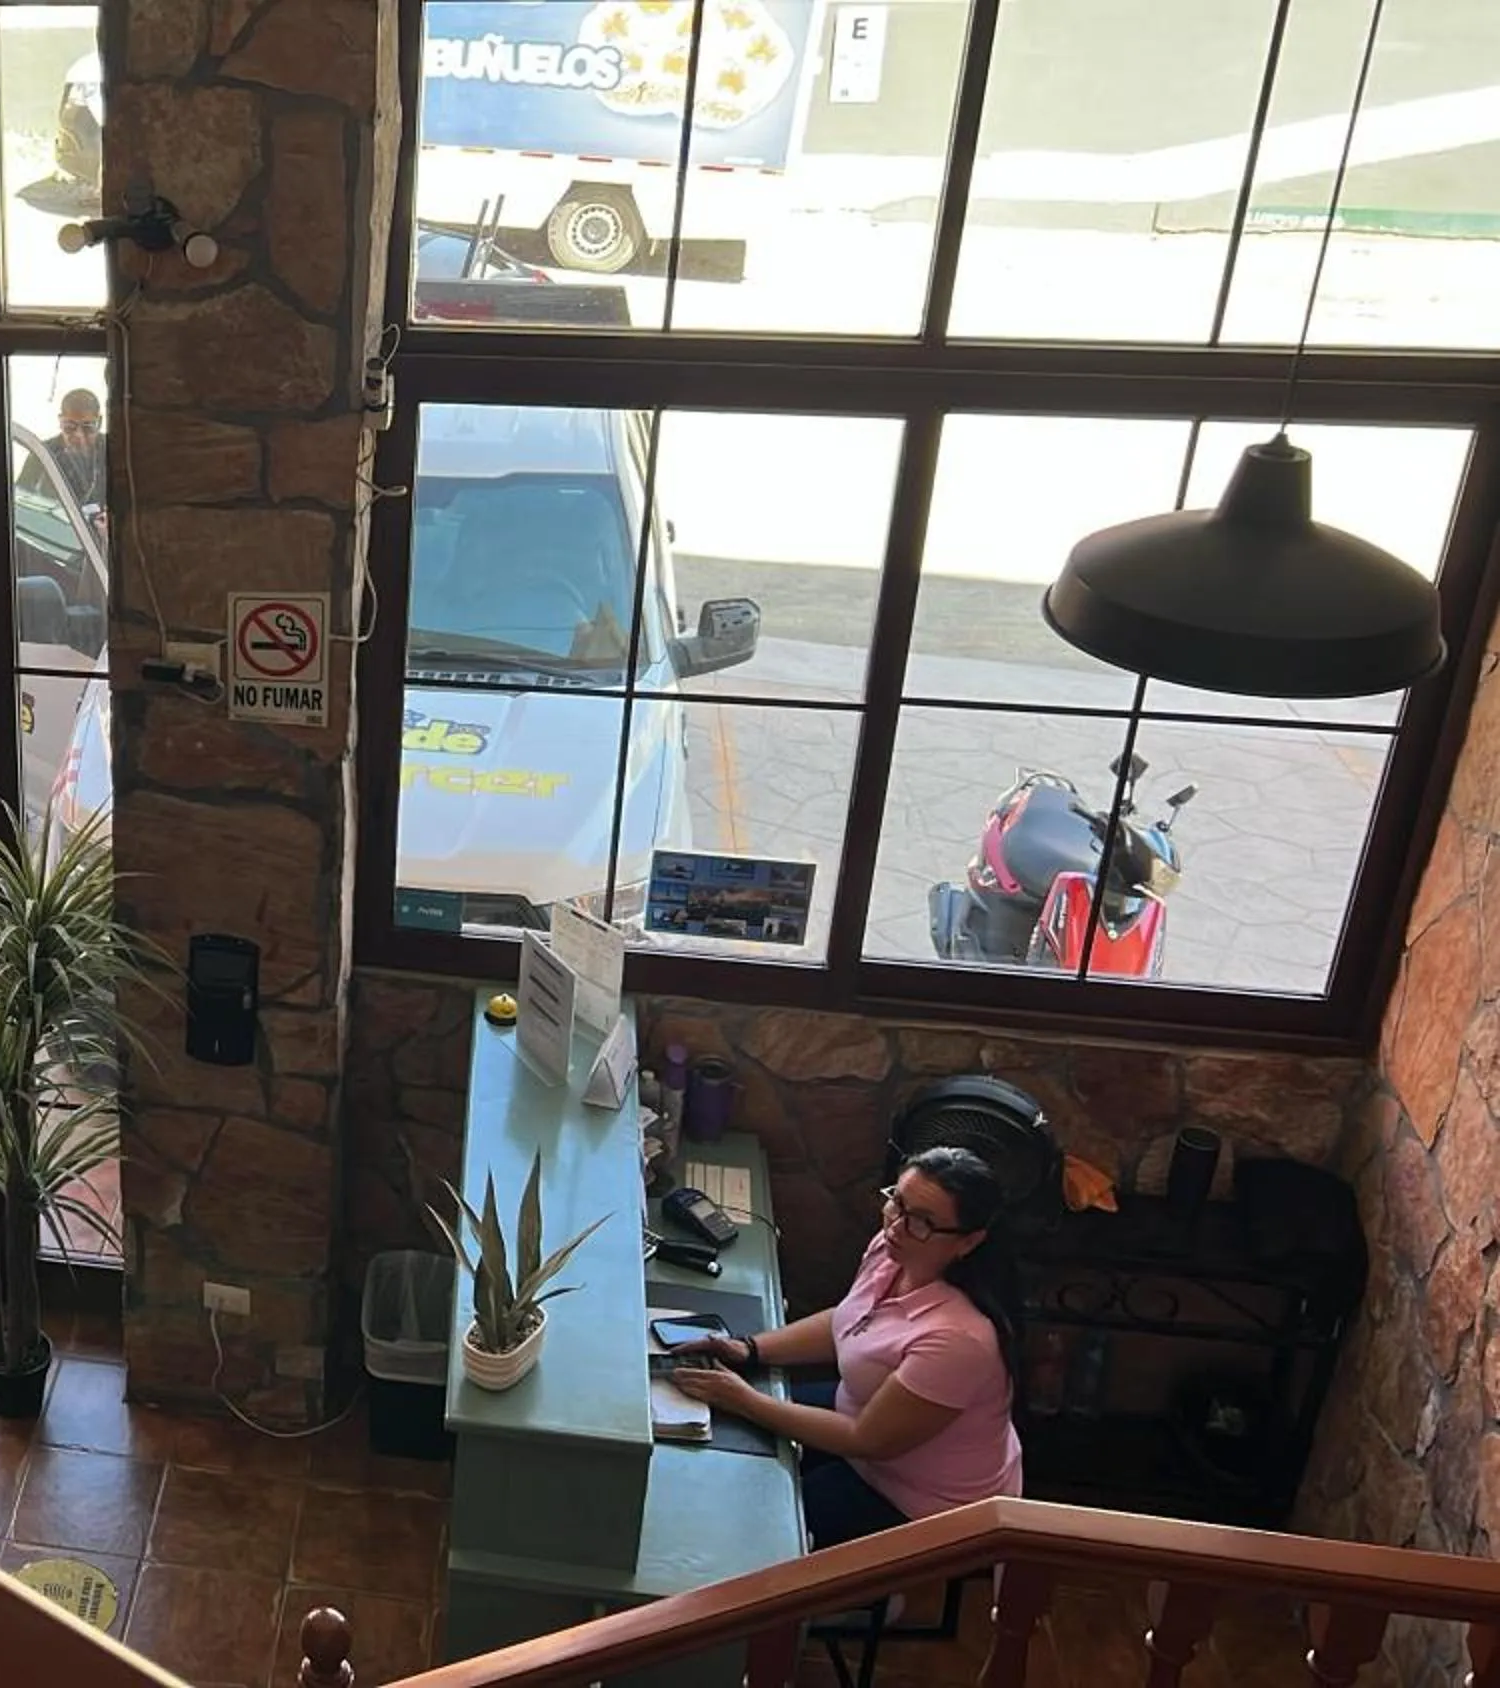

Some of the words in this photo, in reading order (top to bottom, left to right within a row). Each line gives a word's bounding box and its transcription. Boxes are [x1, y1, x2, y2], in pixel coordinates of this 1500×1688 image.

[852, 17, 869, 39] E
[425, 34, 622, 90] BUÑUELOS
[233, 685, 257, 707] NO
[263, 687, 323, 710] FUMAR
